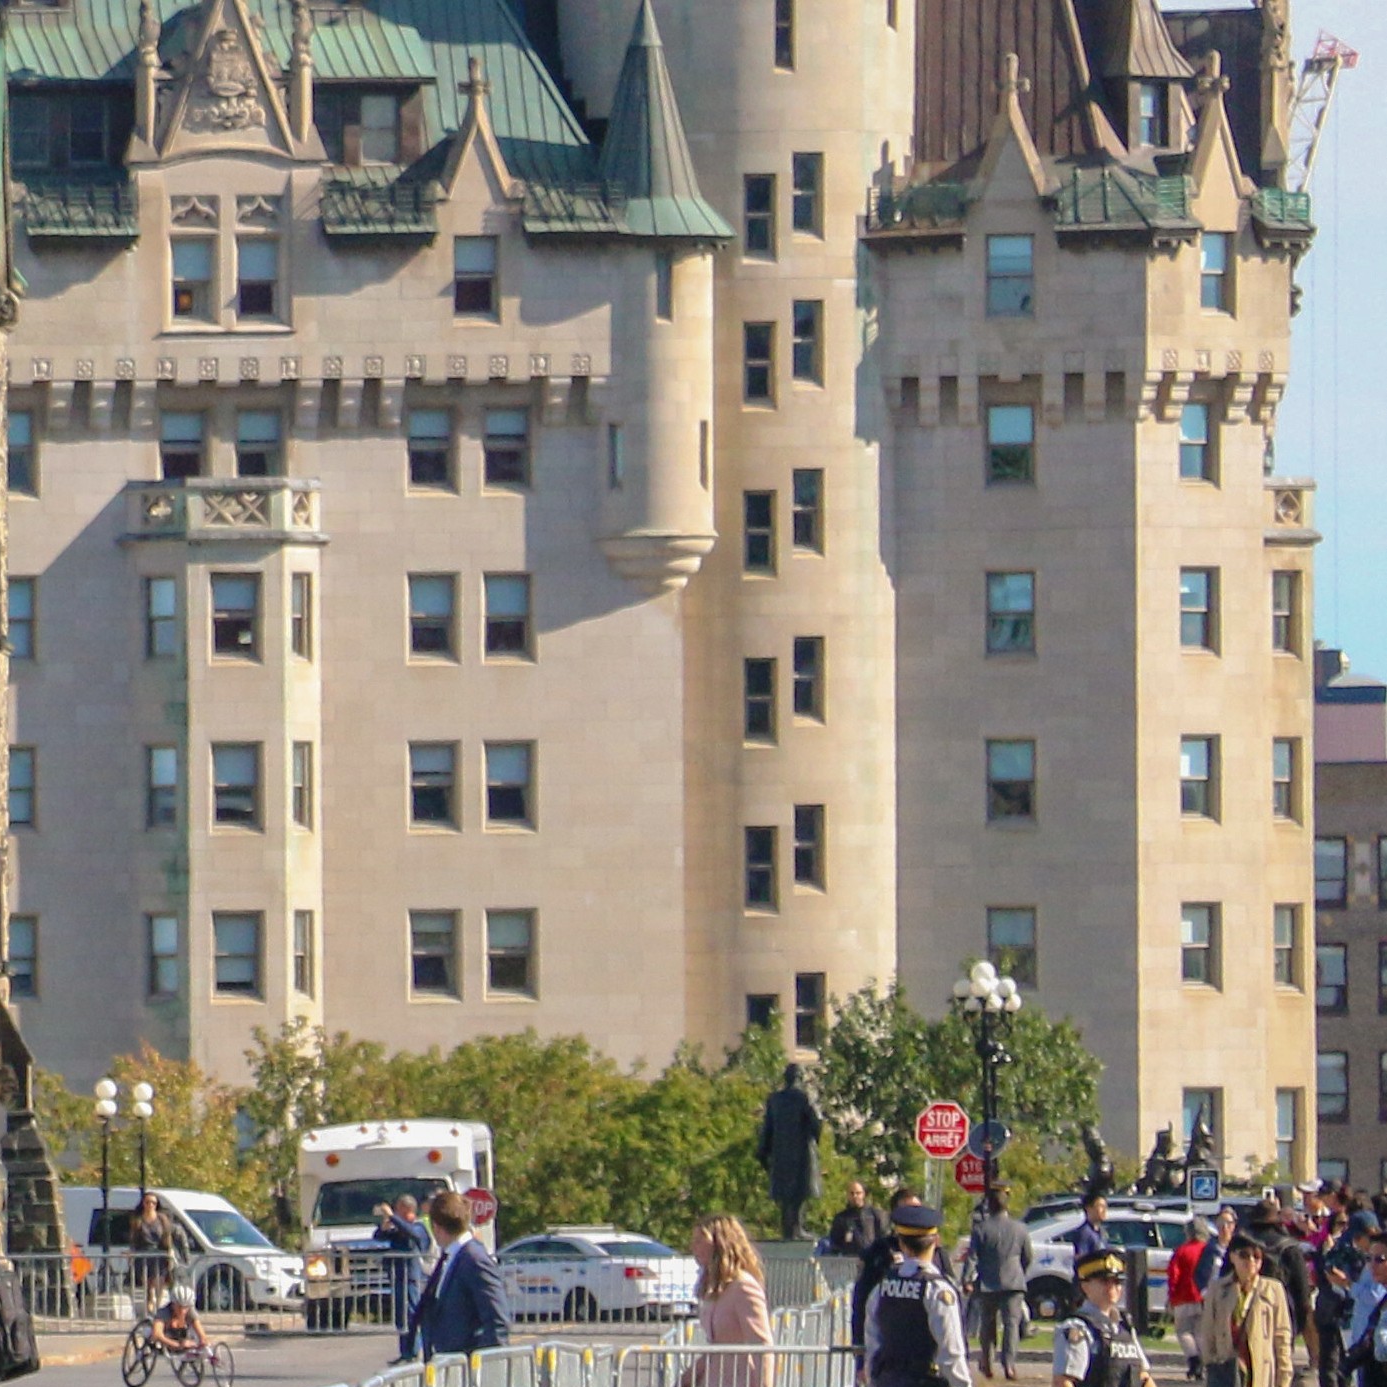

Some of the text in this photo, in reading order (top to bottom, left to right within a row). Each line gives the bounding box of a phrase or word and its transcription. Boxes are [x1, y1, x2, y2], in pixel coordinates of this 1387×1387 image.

[927, 1110, 961, 1128] STOP
[924, 1131, 962, 1147] ARRÊT
[881, 1278, 922, 1300] POLICE
